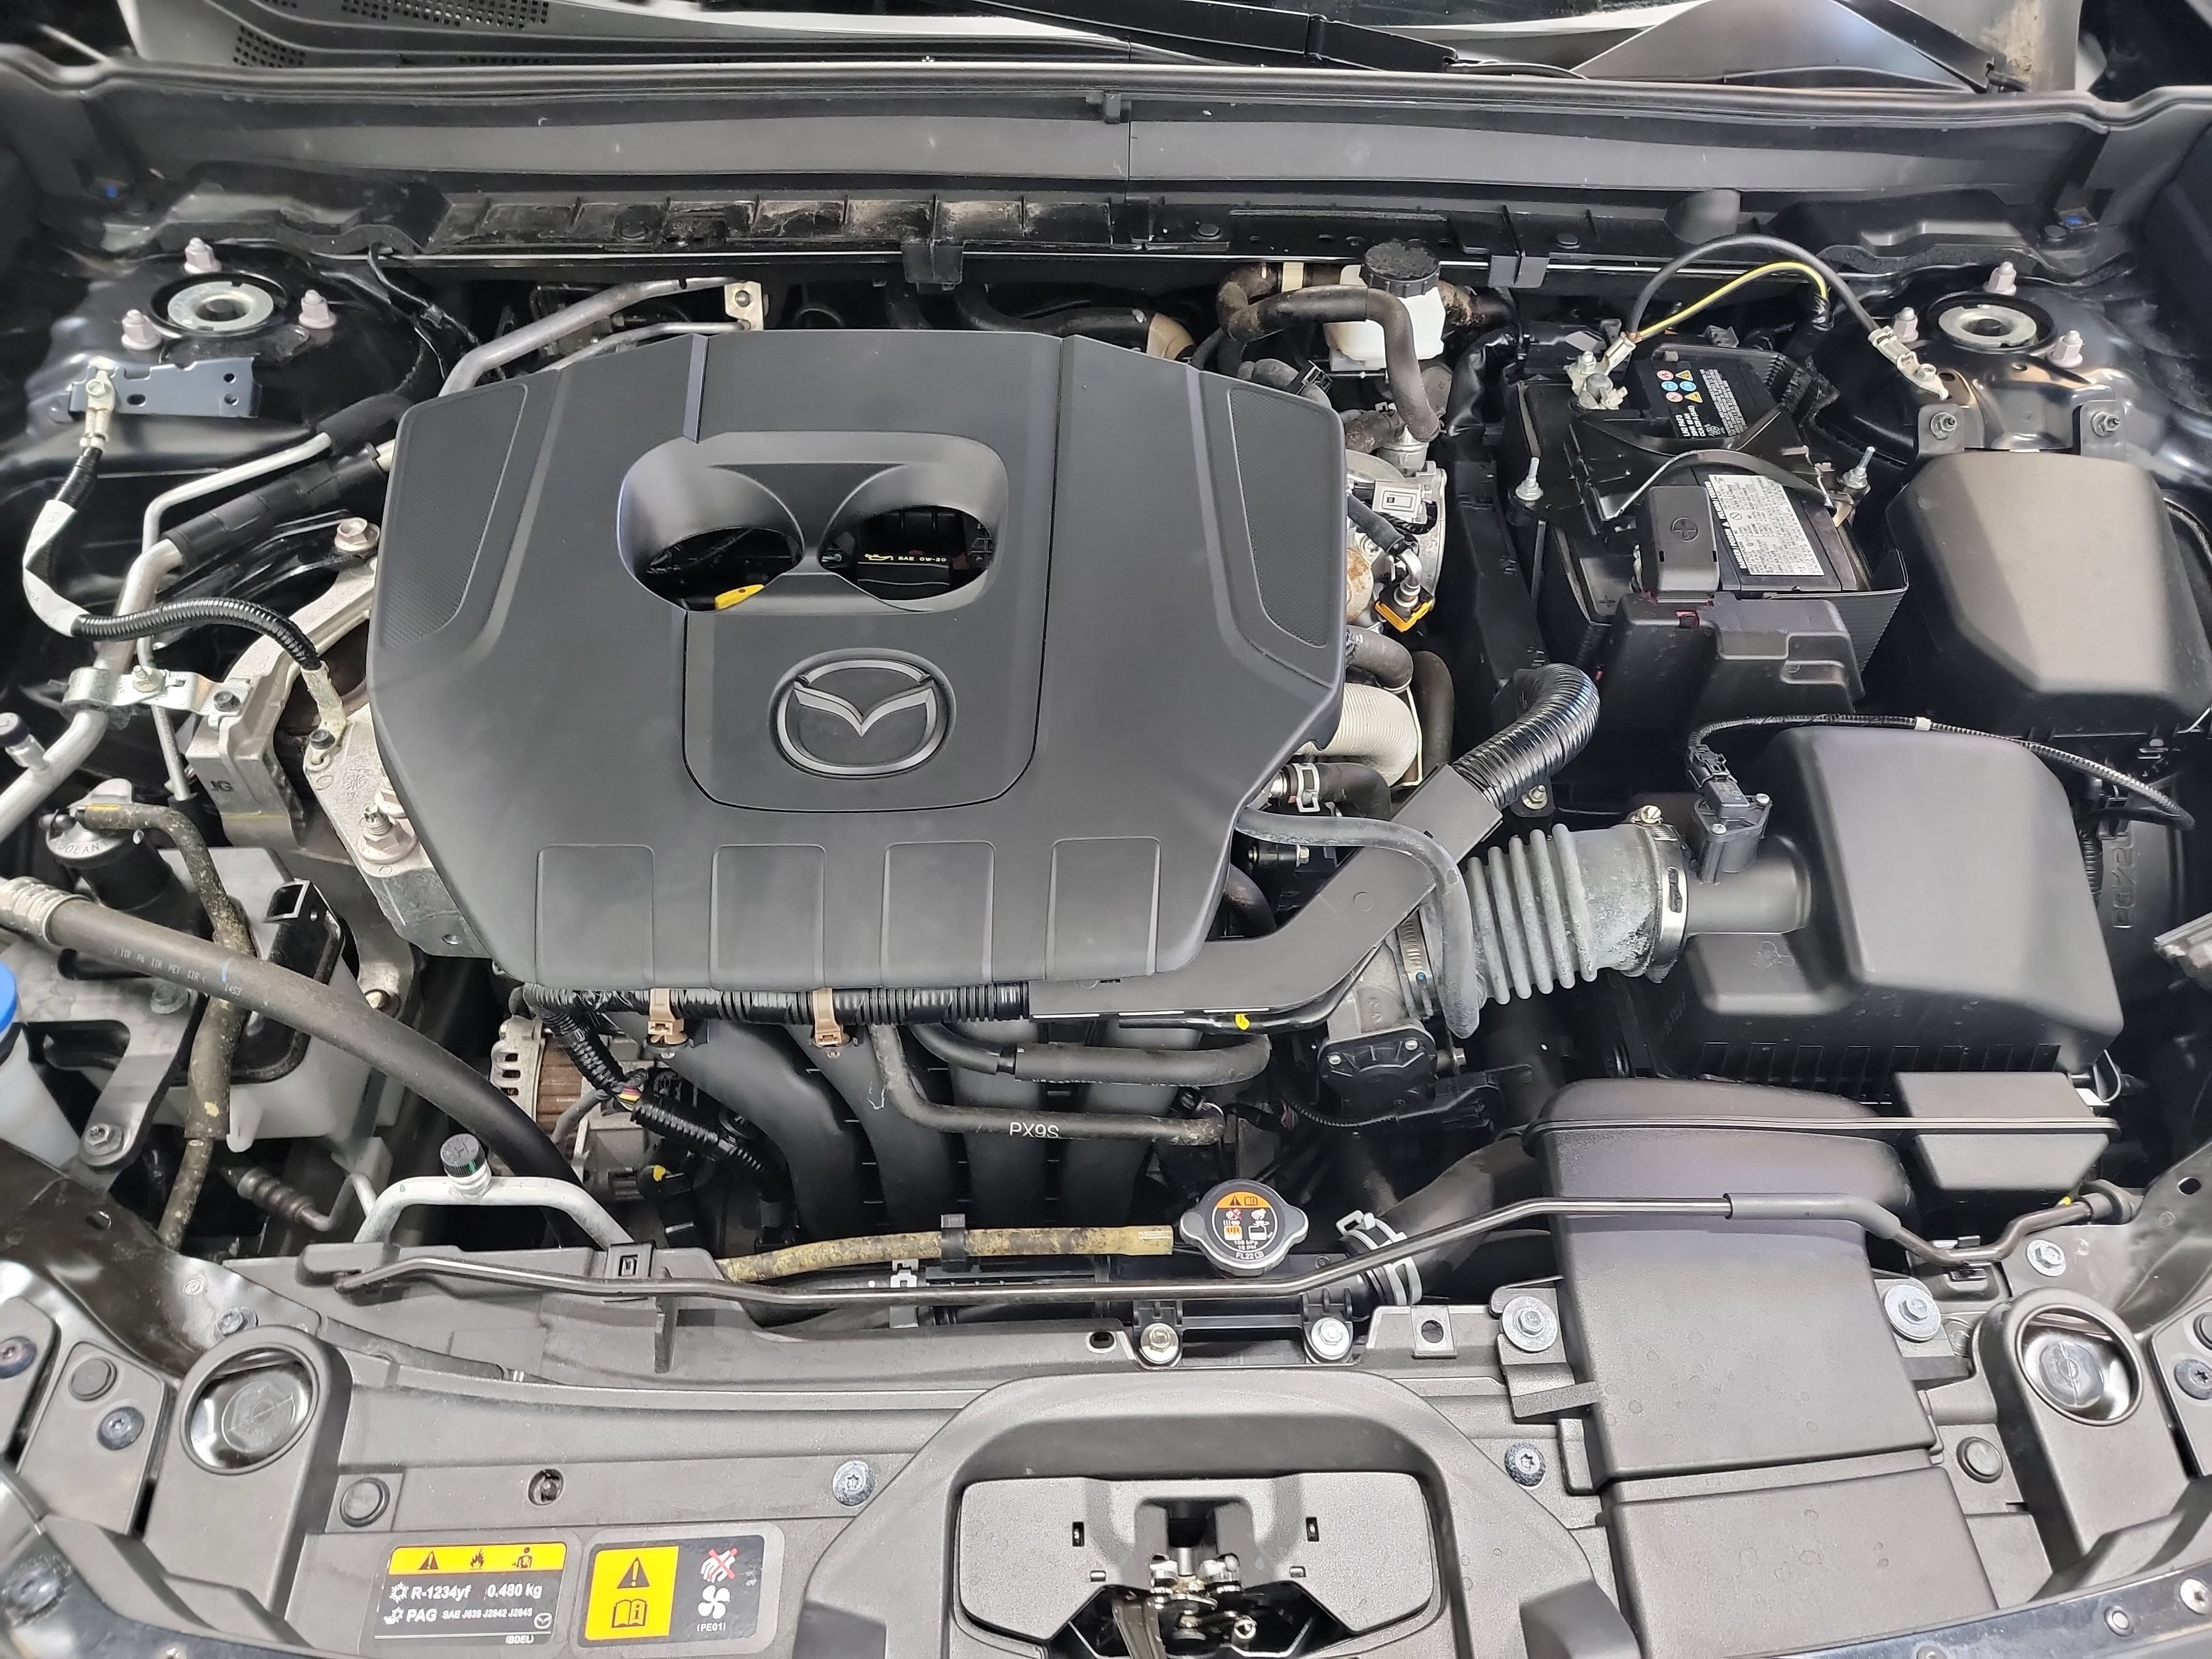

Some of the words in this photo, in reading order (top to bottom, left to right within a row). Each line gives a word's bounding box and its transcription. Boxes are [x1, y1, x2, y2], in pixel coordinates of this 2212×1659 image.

[1009, 1121, 1060, 1139] PX9S
[1235, 1251, 1254, 1260] FL22
[411, 1584, 472, 1601] R-1234yf
[487, 1583, 523, 1598] 0.480
[525, 1583, 543, 1599] kg
[406, 1609, 437, 1622] PAG
[442, 1609, 462, 1619] SAE
[482, 1608, 508, 1618] J2842
[697, 1622, 726, 1632] (PE01)
